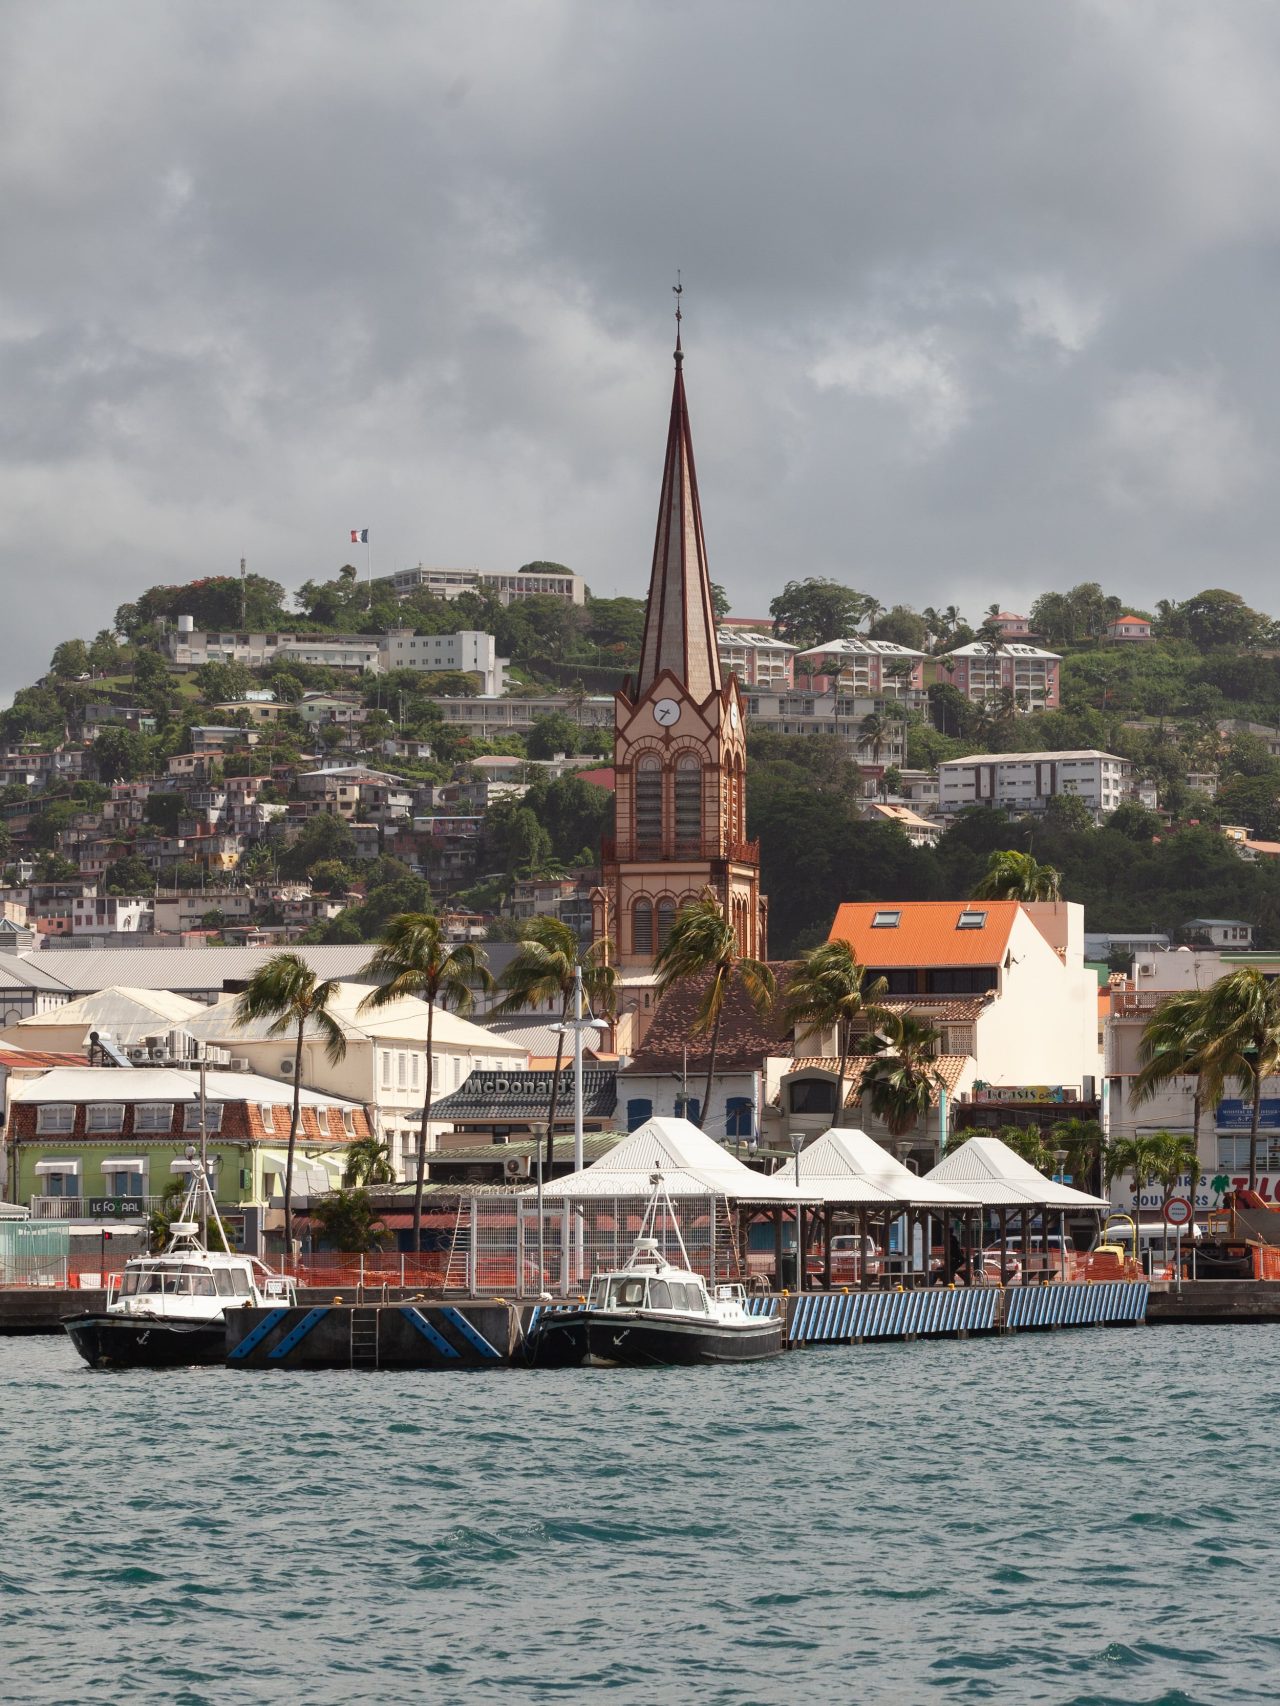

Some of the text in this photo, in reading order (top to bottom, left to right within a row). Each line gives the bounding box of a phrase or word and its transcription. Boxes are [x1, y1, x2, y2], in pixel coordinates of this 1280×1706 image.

[464, 1079, 576, 1094] McDonald's
[92, 1202, 102, 1212] LE
[1131, 1195, 1209, 1207] SOUVRS
